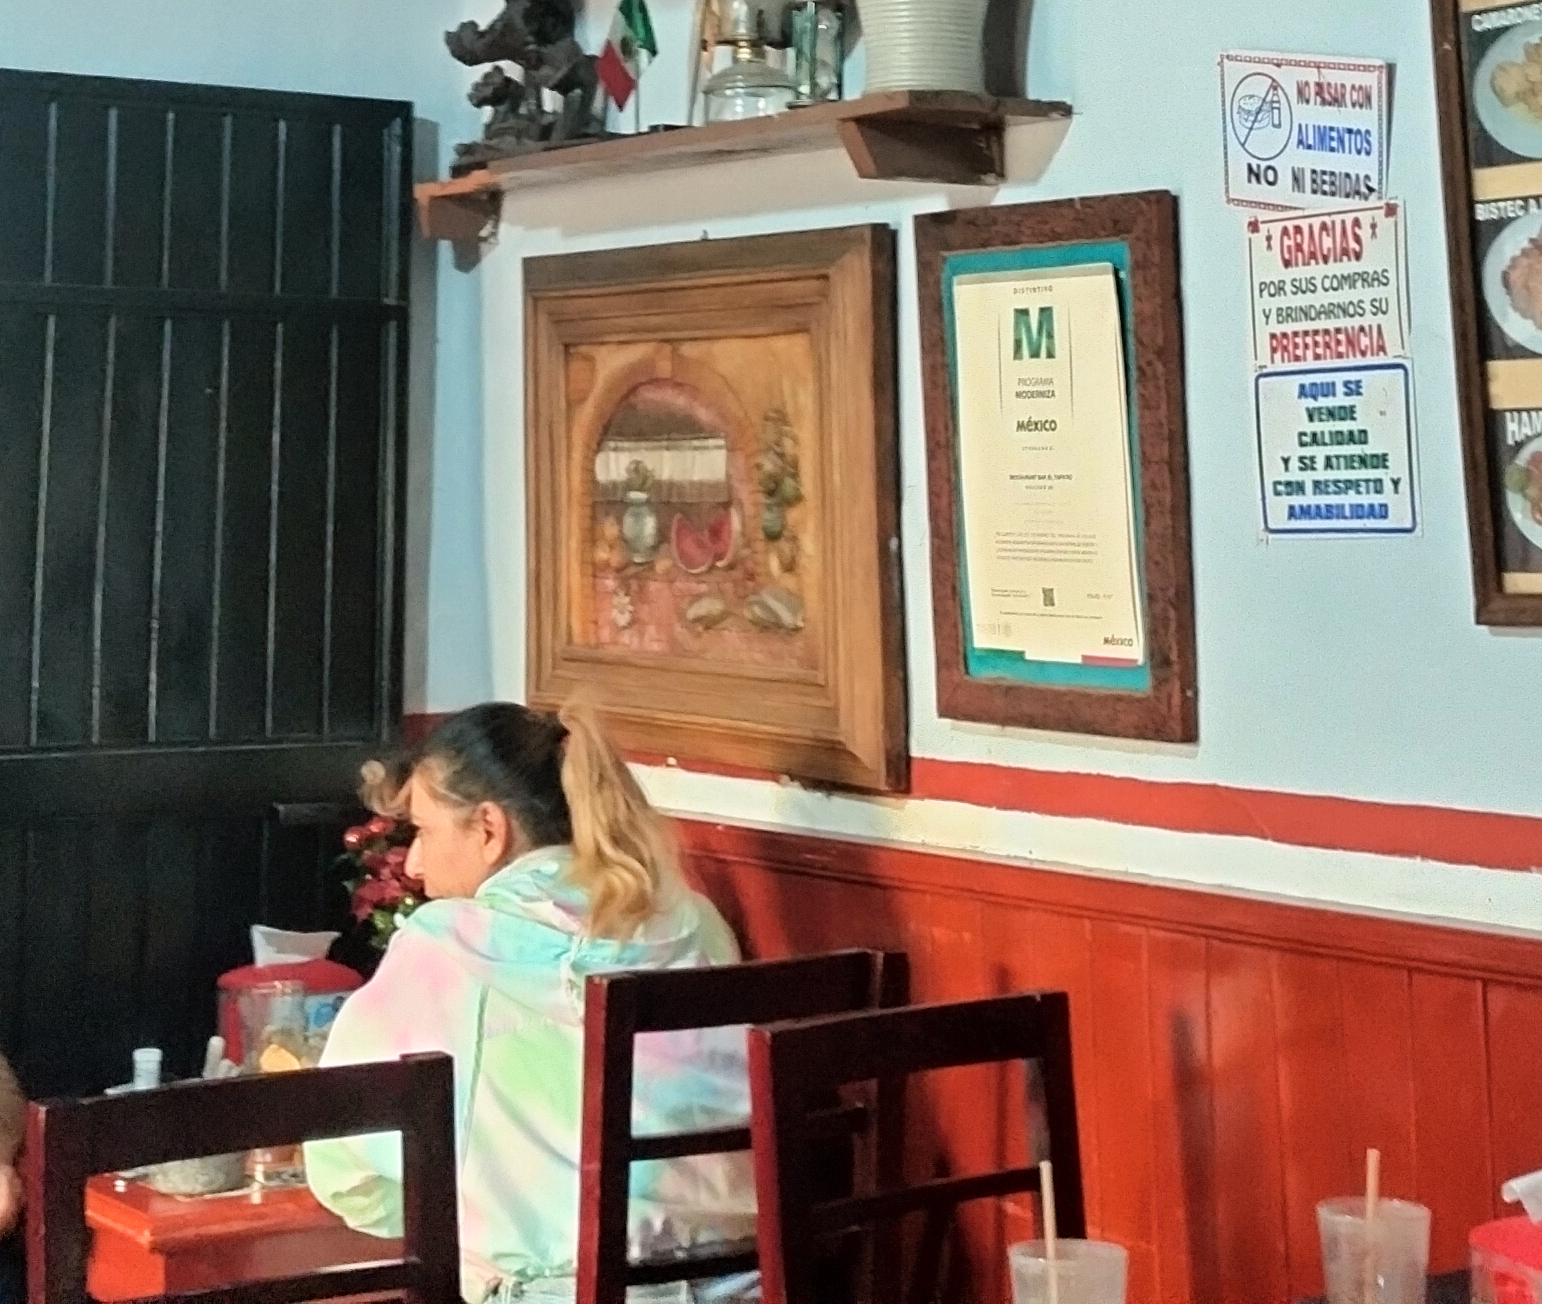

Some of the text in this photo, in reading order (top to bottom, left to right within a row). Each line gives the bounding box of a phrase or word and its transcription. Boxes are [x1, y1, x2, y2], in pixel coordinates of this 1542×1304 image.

[1296, 80, 1373, 111] NO PASAR CON
[1296, 123, 1373, 157] ALIMENTOS
[1246, 162, 1279, 187] NO
[1291, 166, 1373, 201] NI BEBIDAS
[1474, 199, 1526, 221] BISTEC
[1528, 198, 1539, 214] A
[1279, 216, 1364, 269] GRACIAS
[1259, 268, 1390, 299] POR SUS COMPRAS
[1262, 297, 1389, 326] Y BRINDARNOS SU
[1012, 306, 1056, 361] M
[1269, 323, 1388, 365] PREFERENCIA
[1015, 389, 1056, 399] MODERNIZA
[1017, 377, 1055, 387] PROGRAMA
[1297, 379, 1364, 403] AQUI SE
[1305, 404, 1357, 423] VENDE
[1297, 428, 1369, 448] CALIDAD
[1280, 452, 1390, 473] Y SE ATIENDE
[1272, 476, 1402, 498] CON RESPETO Y
[1287, 502, 1389, 521] AMABILIDAD
